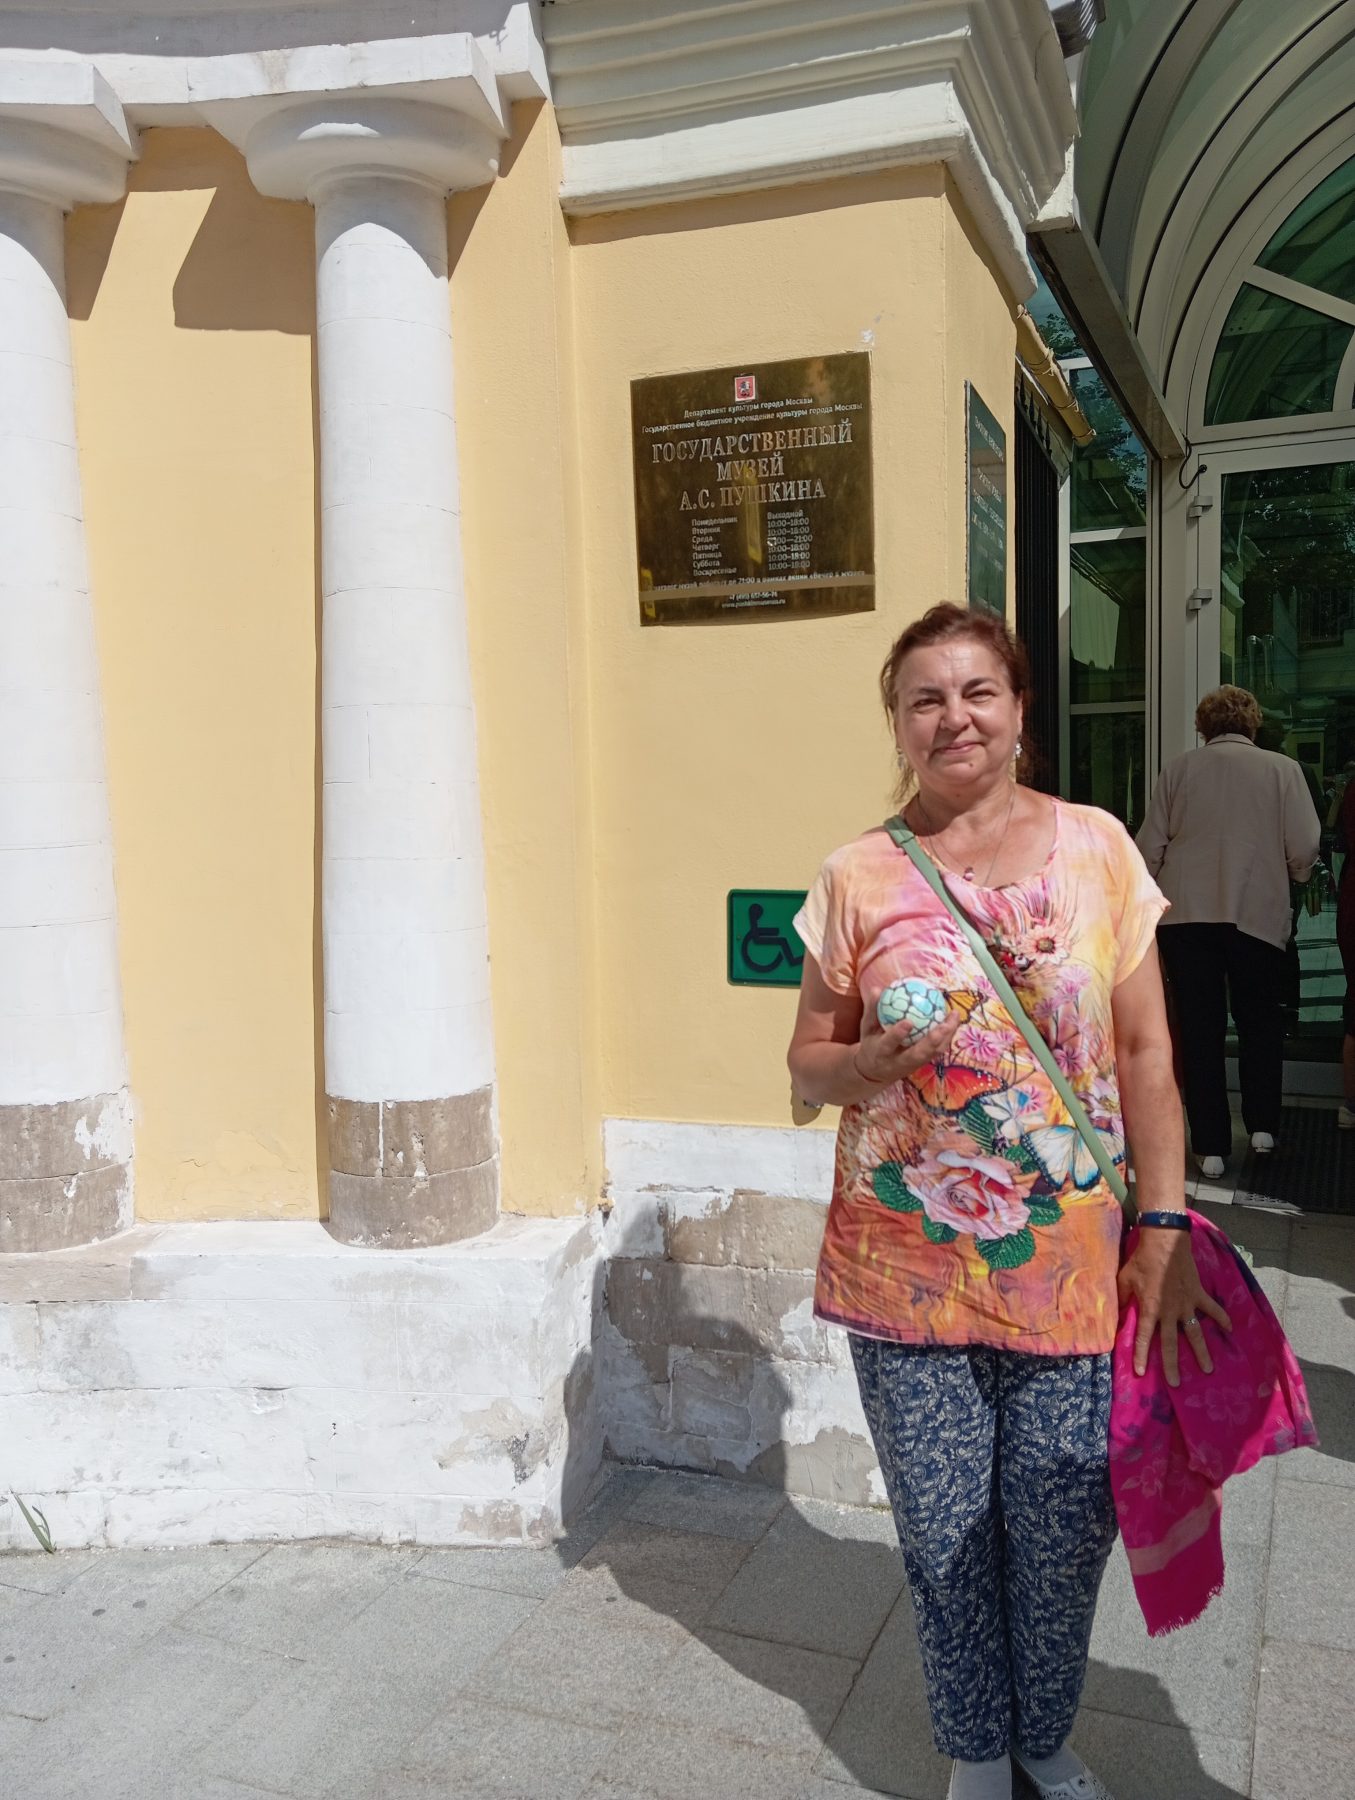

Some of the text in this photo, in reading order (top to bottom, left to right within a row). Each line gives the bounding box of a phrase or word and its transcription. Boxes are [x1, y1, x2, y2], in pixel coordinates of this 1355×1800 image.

[684, 398, 813, 418] Департамент культуры города Москвы
[642, 403, 863, 434] Государственное бюджетное учреждение культуры города Москвы
[652, 418, 853, 463] ГОСУДАРСТВЕННЫЙ
[716, 451, 785, 482] МУЗЕЙ
[679, 478, 826, 511] А.С. ПУШКИНА
[691, 509, 804, 527] Понедельник Выходной
[691, 526, 721, 535] Вторник
[691, 535, 713, 544] Среда
[692, 543, 721, 551] Четверг
[692, 551, 723, 560] Пятница
[692, 560, 720, 569] Суббота
